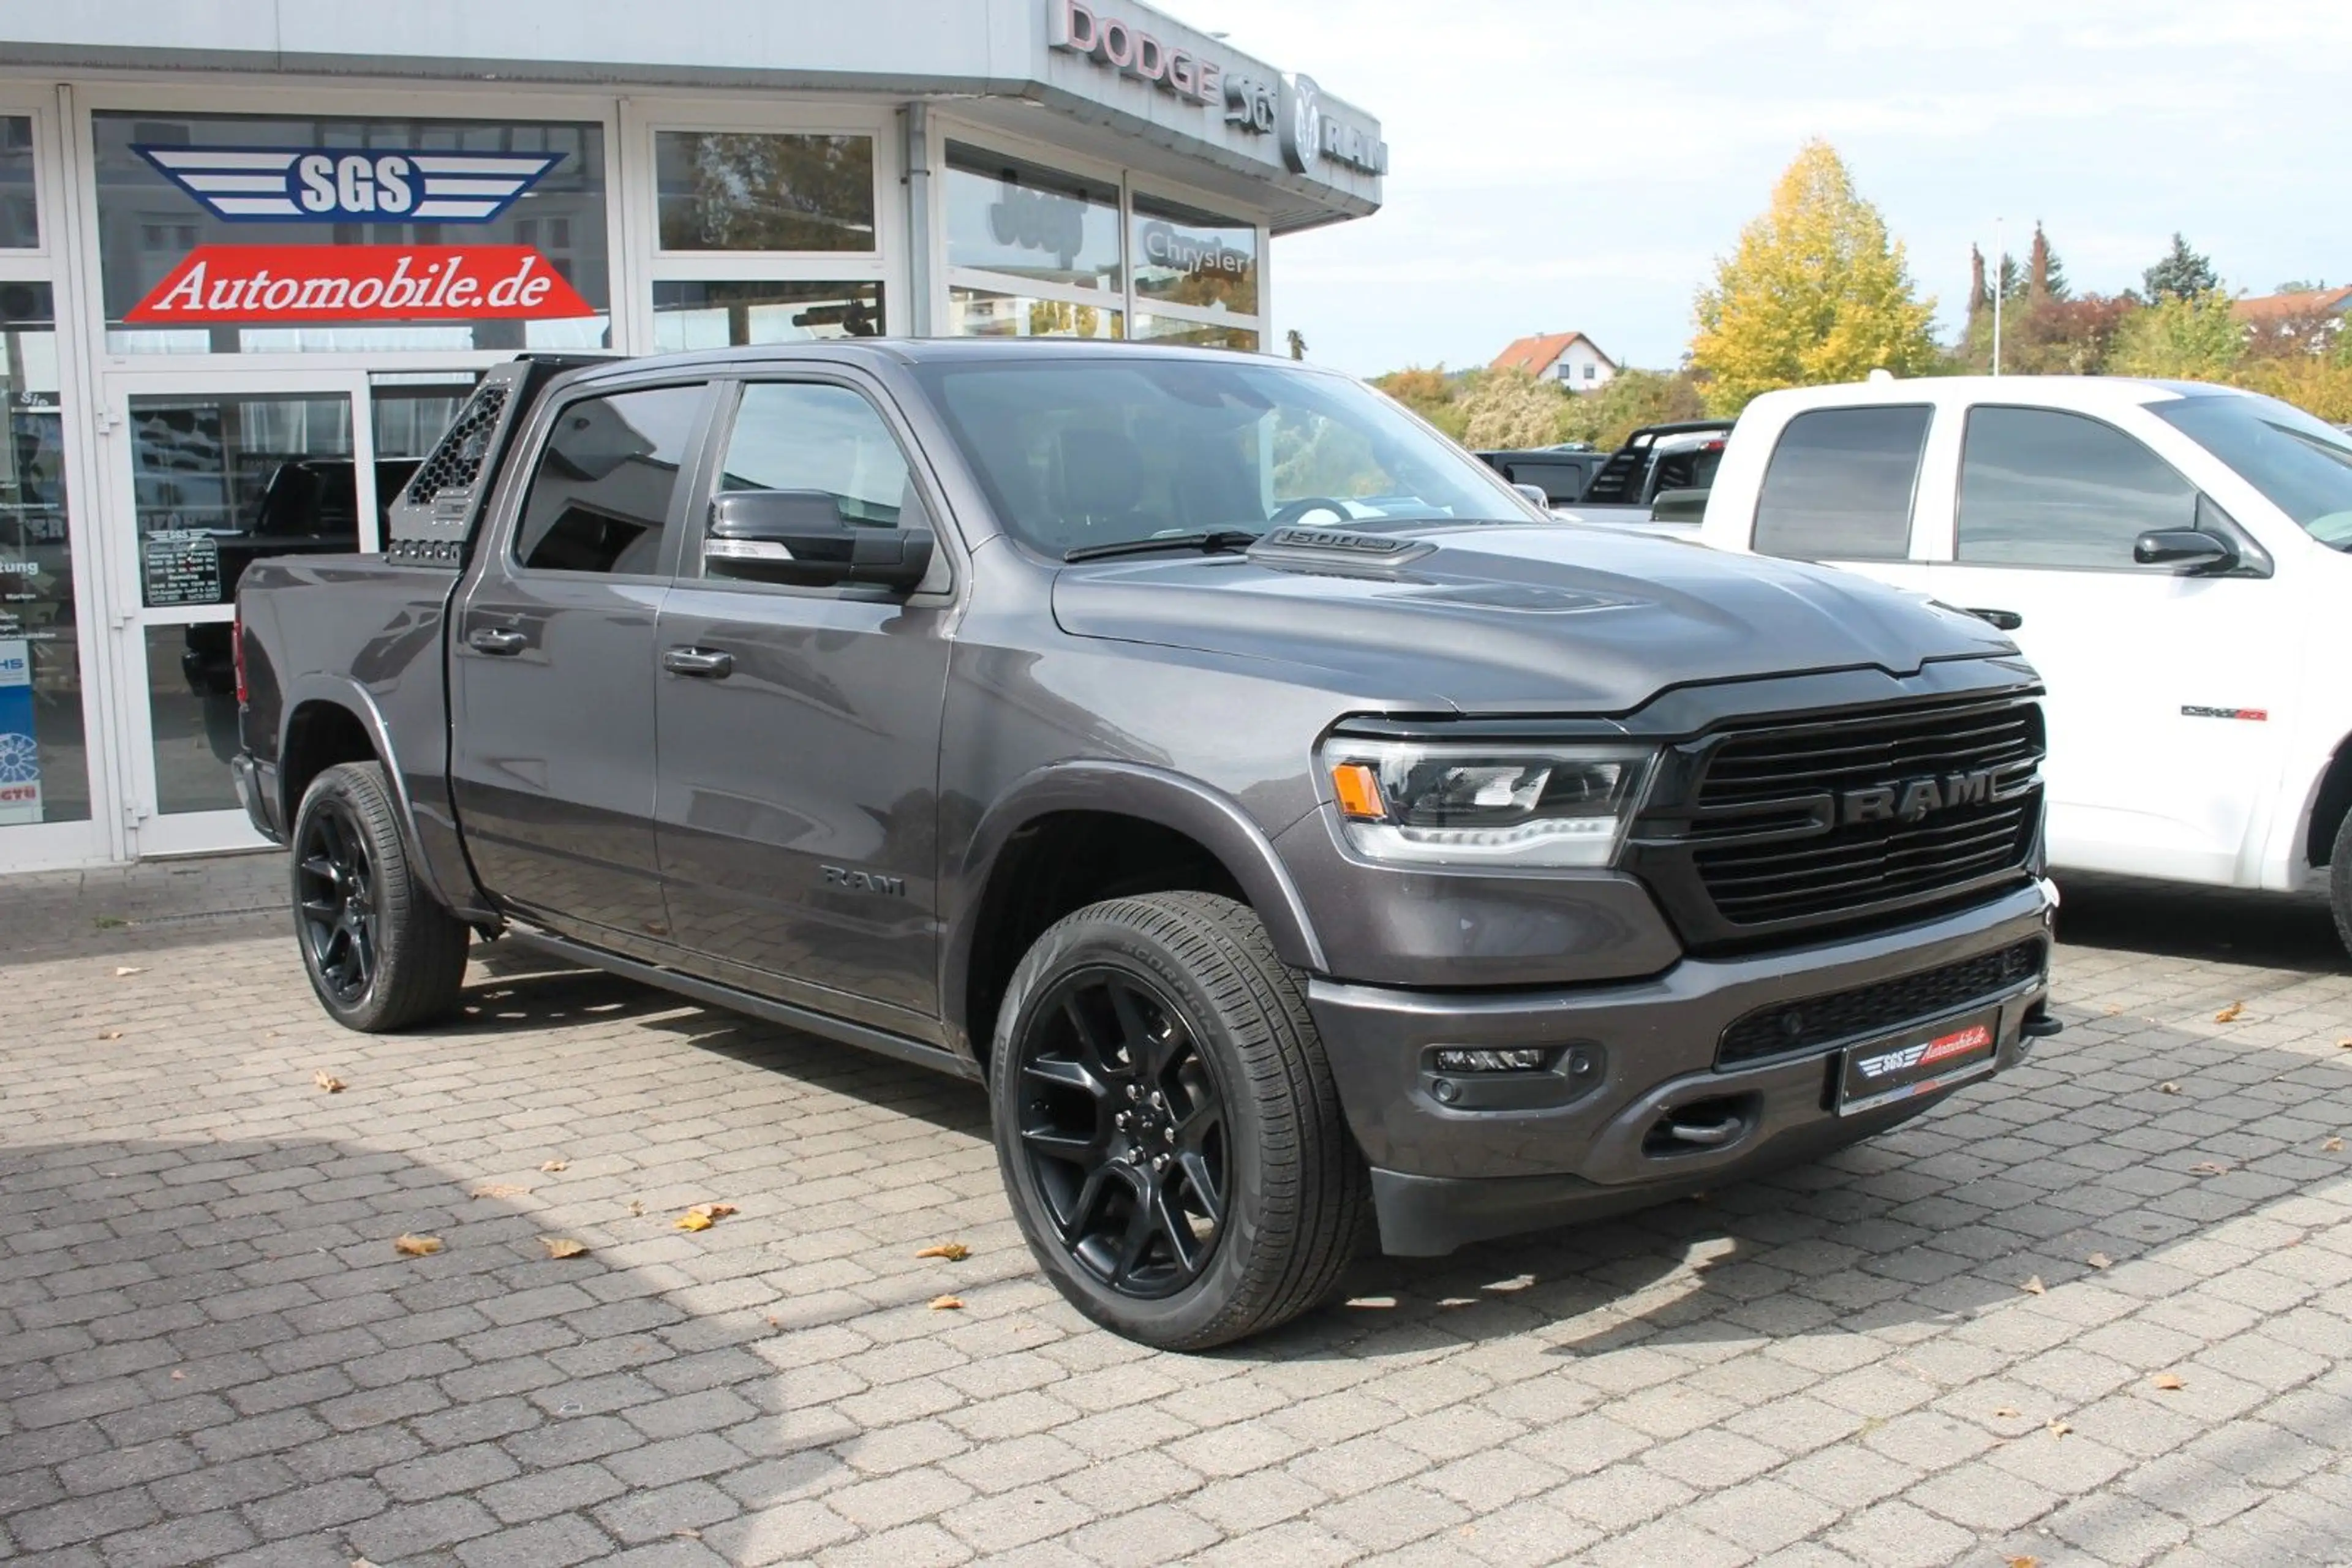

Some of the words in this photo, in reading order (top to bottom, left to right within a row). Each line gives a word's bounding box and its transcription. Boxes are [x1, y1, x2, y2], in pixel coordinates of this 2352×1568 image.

[1063, 0, 1219, 105] DODGE
[298, 154, 412, 213] SGS
[1146, 231, 1246, 275] Chrysler
[152, 255, 551, 311] Automobile.de
[1843, 770, 1989, 823] RAM
[819, 864, 905, 897] RAM
